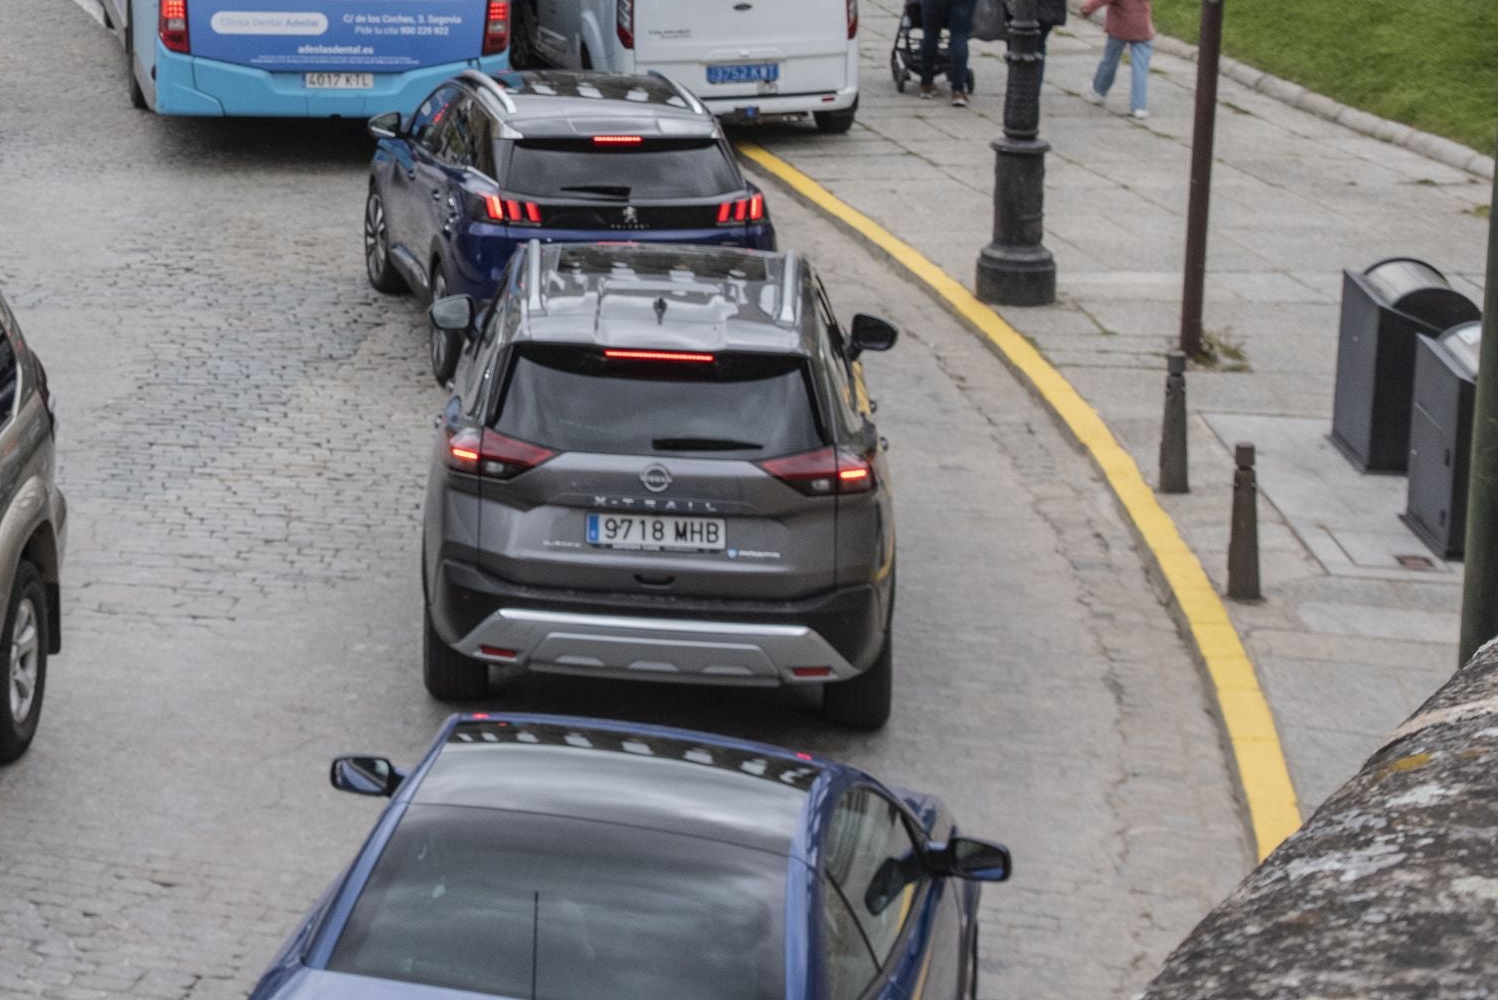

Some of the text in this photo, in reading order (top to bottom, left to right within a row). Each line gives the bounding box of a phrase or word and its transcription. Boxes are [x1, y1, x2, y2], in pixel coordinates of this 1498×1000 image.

[355, 14, 366, 23] de
[427, 14, 462, 26] Segovia
[308, 74, 370, 87] 4017 KTL
[604, 518, 720, 544] 9718 MHB
